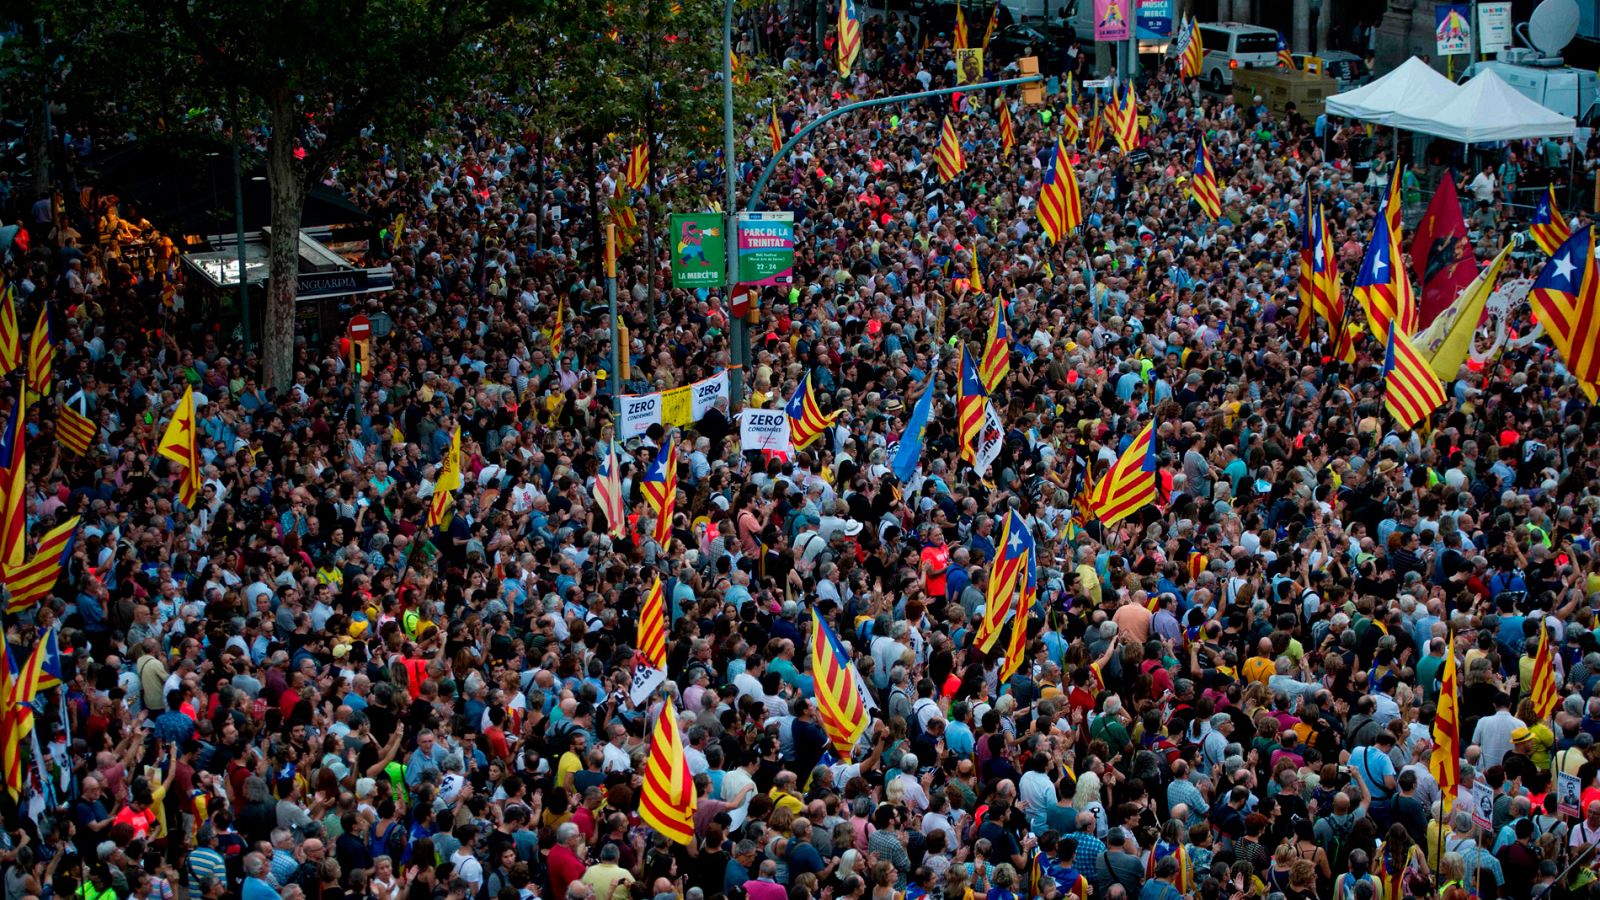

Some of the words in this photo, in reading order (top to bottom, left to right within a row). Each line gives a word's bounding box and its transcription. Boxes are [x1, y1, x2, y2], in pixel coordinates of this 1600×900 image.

[959, 50, 976, 59] FREE
[744, 228, 765, 236] PARC
[767, 228, 777, 236] DE
[779, 228, 788, 236] LA
[748, 238, 785, 247] TRINITAT
[297, 276, 356, 290] ANGUARDIA
[699, 383, 721, 397] ZERO
[628, 400, 655, 414] ZERO
[750, 415, 784, 425] ZERO
